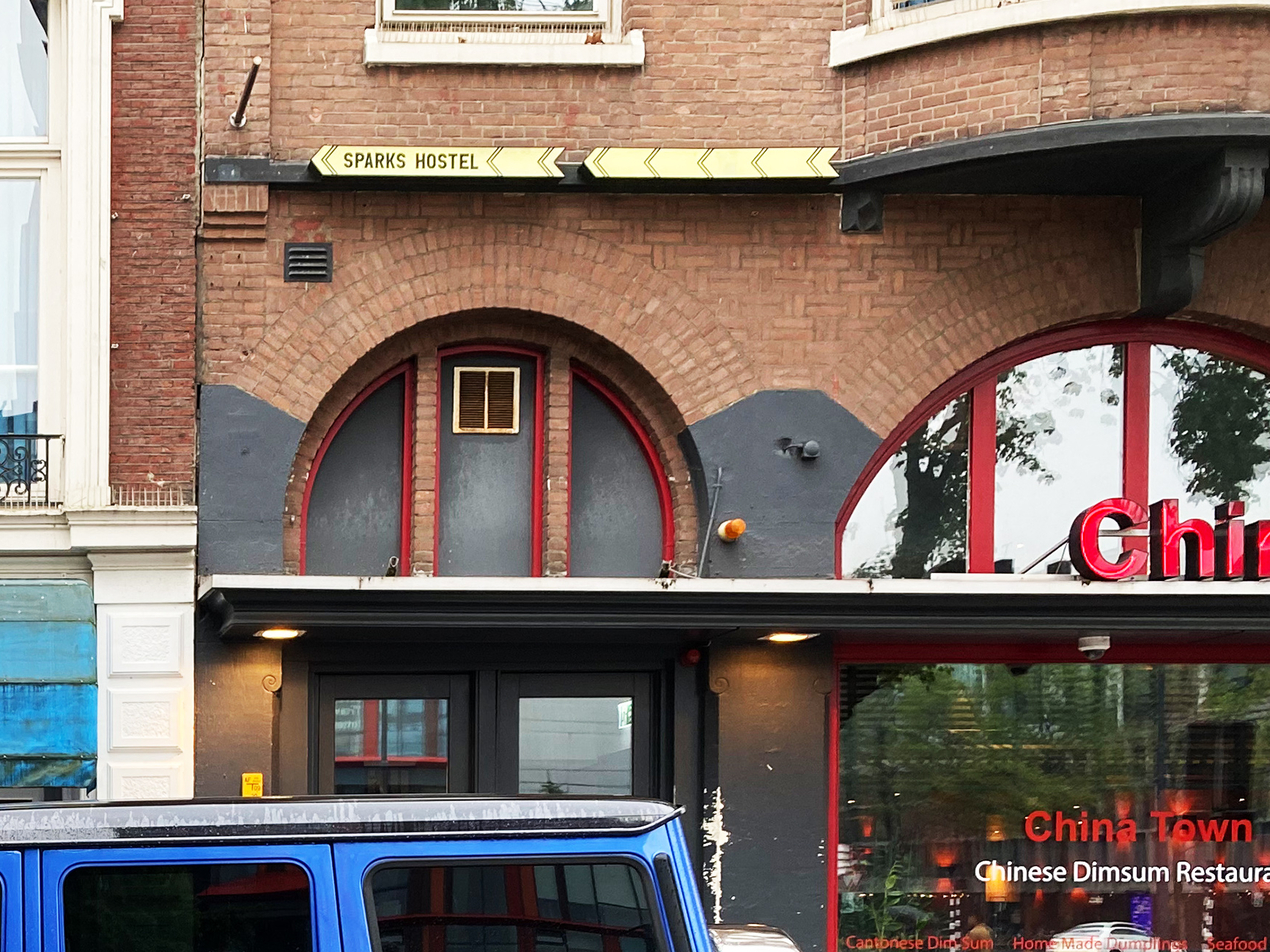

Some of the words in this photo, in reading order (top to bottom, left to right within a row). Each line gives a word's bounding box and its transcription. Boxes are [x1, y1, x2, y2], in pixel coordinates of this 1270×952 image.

[343, 152, 406, 169] SPARKS
[415, 153, 479, 170] HOSTEL
[1024, 810, 1137, 842] China
[1150, 810, 1252, 842] Town
[974, 860, 1067, 883] Chinese
[1072, 860, 1170, 883] Dimsum
[845, 935, 924, 950] Cantonese
[927, 935, 959, 950] Dim
[961, 936, 994, 950] Sum
[1013, 936, 1057, 950] Home
[1062, 935, 1103, 950] Made
[1206, 935, 1267, 950] Seafood
